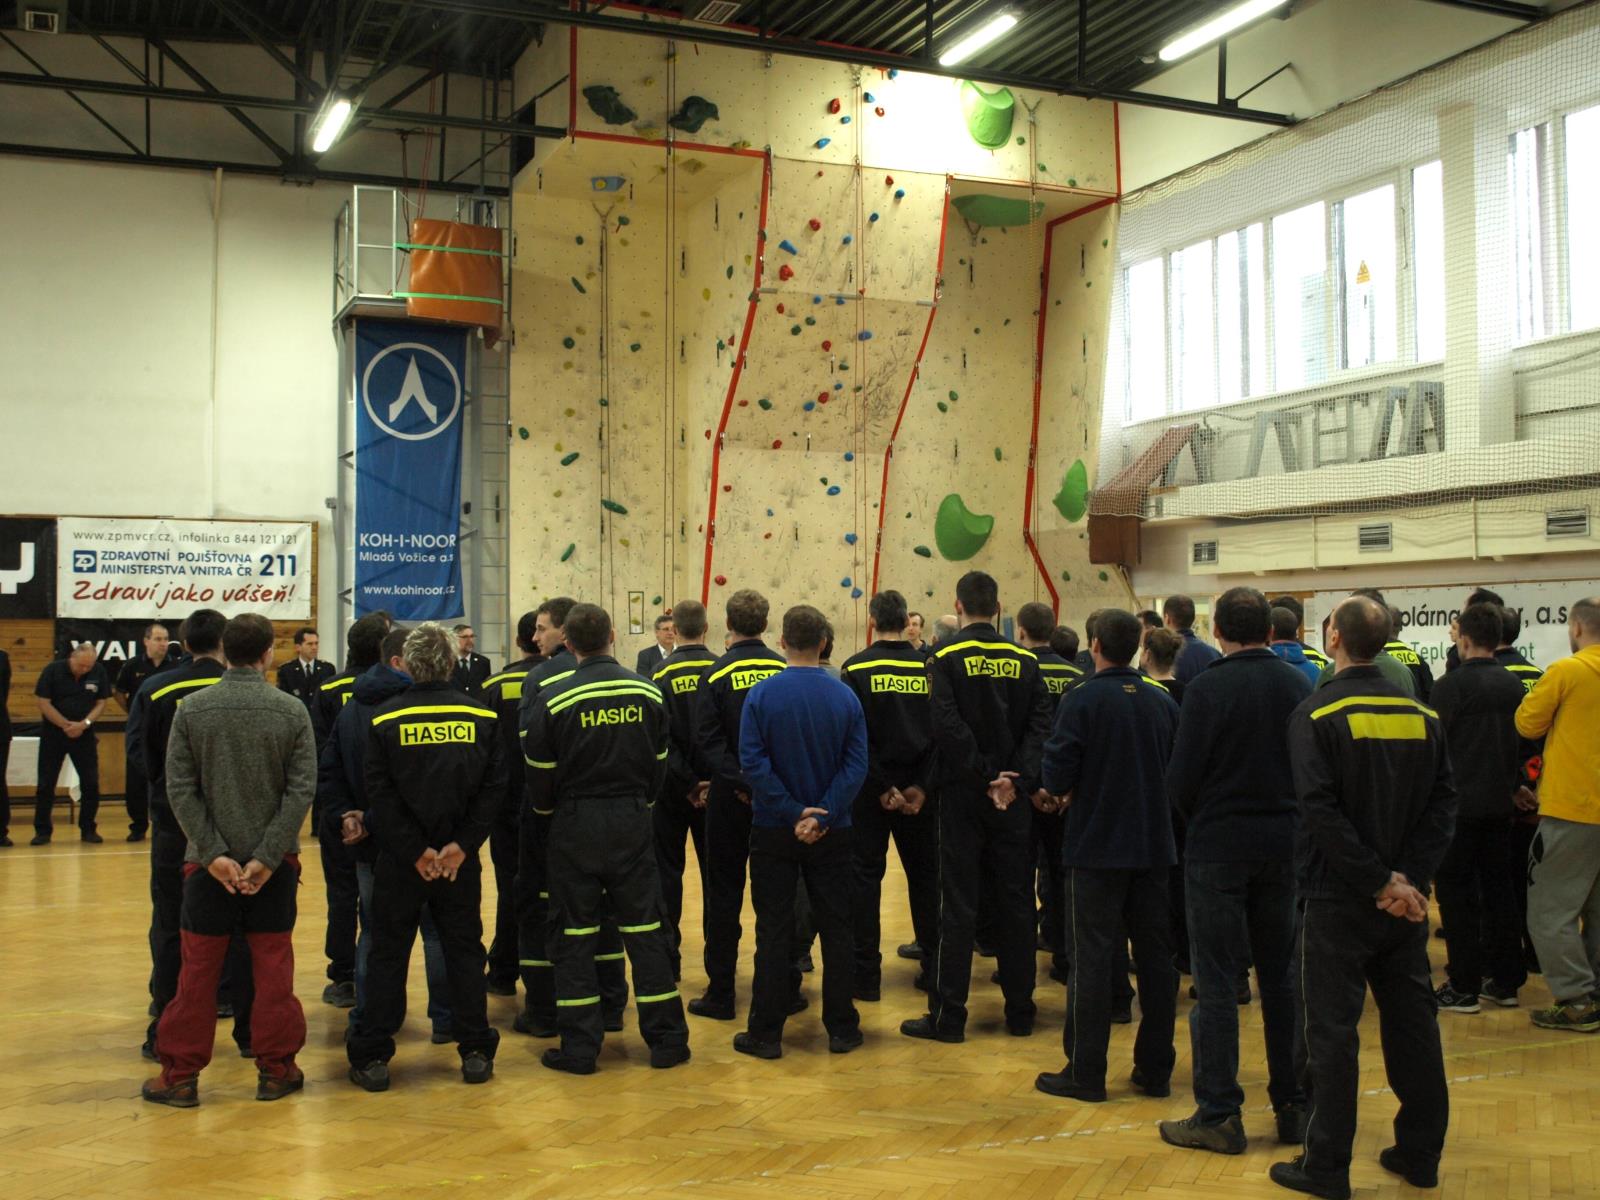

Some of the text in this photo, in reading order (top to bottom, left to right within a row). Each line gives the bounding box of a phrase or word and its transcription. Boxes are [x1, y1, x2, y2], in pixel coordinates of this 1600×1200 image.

[179, 532, 230, 544] infolinka
[235, 534, 255, 543] 844
[261, 534, 276, 544] 121
[282, 535, 297, 544] 121
[361, 533, 456, 548] KOH-I-NOOR
[101, 548, 252, 563] ZDRAVOTNÍ POJIŠŤOVNA
[360, 552, 395, 562] Mladá
[399, 552, 436, 562] Vožice
[101, 564, 252, 576] MINISTERSTVA VNITRA ČR
[260, 554, 296, 576] 211
[73, 580, 295, 608] Zdraví jako vášeň!
[364, 585, 455, 595] www.kohinoor.cz
[1411, 641, 1449, 664] Tepl
[581, 704, 643, 728] HASIČI
[404, 723, 472, 743] HASIČI
